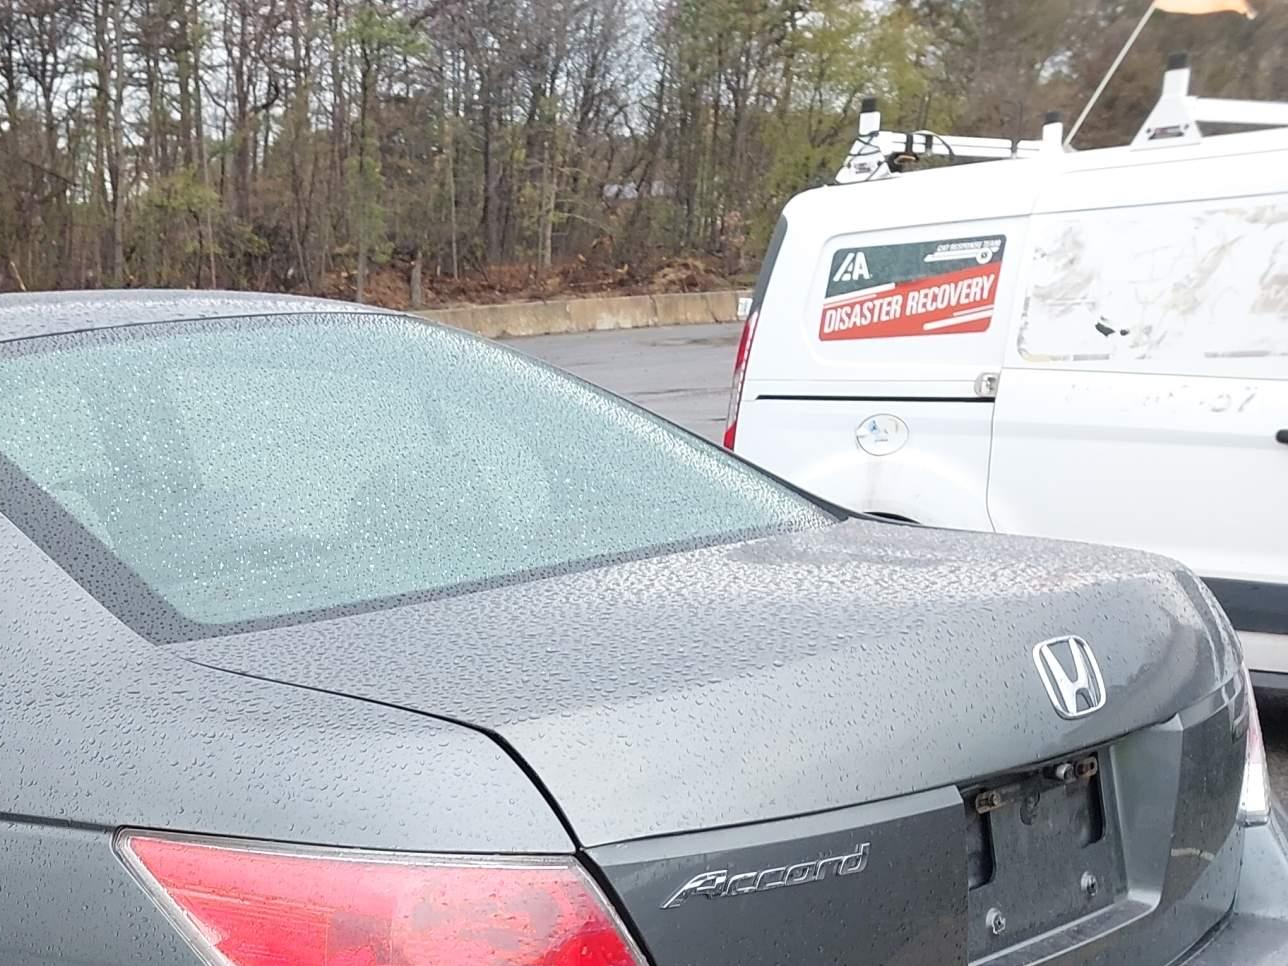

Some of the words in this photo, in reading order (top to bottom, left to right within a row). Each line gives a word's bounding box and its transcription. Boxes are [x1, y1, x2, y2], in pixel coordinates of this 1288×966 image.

[823, 294, 903, 334] DISASTER
[906, 274, 995, 316] RECOVERY
[659, 842, 872, 909] Accord
